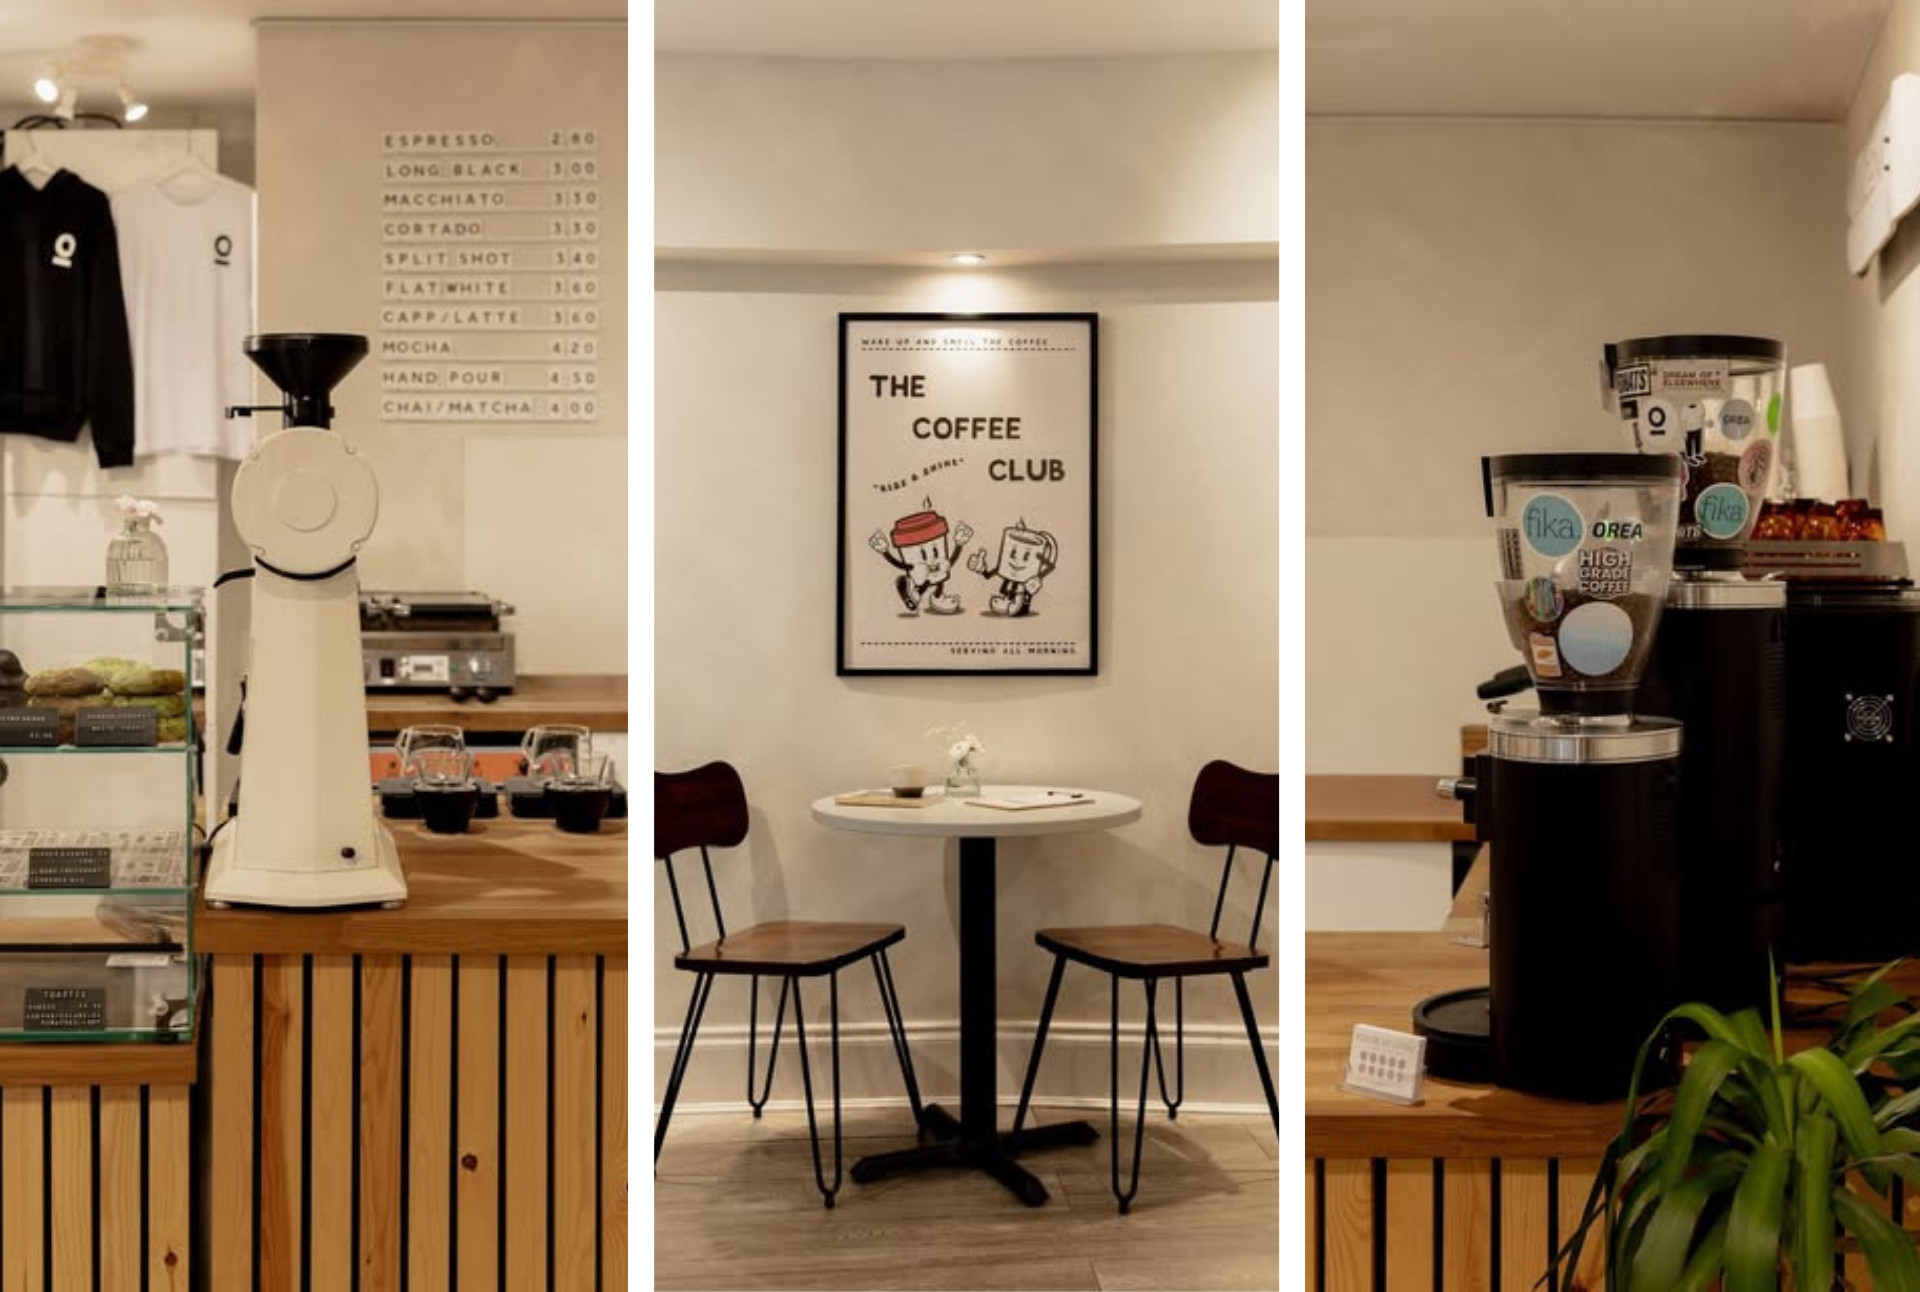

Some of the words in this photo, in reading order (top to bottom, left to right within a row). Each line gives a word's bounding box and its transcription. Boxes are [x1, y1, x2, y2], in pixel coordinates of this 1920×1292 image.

[384, 133, 493, 148] ESPRESSO
[386, 164, 440, 177] LONG
[453, 163, 519, 177] BLACK
[383, 193, 505, 206] MACCHIATO
[384, 223, 481, 236] CORTADO
[385, 252, 445, 265] SPLIT
[459, 252, 509, 265] SHOT
[386, 281, 437, 295] FLAT
[446, 281, 507, 295] WHITE
[383, 310, 518, 324] CAPP/LATTE
[382, 341, 451, 353] MOCHA
[861, 338, 890, 346] WAKE
[896, 338, 910, 346] UP
[915, 338, 936, 346] AND
[1008, 338, 1048, 346] COFFEE
[383, 371, 439, 384] HAND
[449, 371, 501, 384] POUR
[869, 375, 926, 398] THE
[383, 401, 530, 414] CHAI/MATCHA
[912, 417, 1021, 439] COFFEE
[988, 459, 1065, 481] CLUB
[1592, 521, 1643, 539] OREA
[1579, 551, 1631, 567] HIGH
[1579, 567, 1630, 580] GRADE
[1579, 581, 1632, 595] COFFEE
